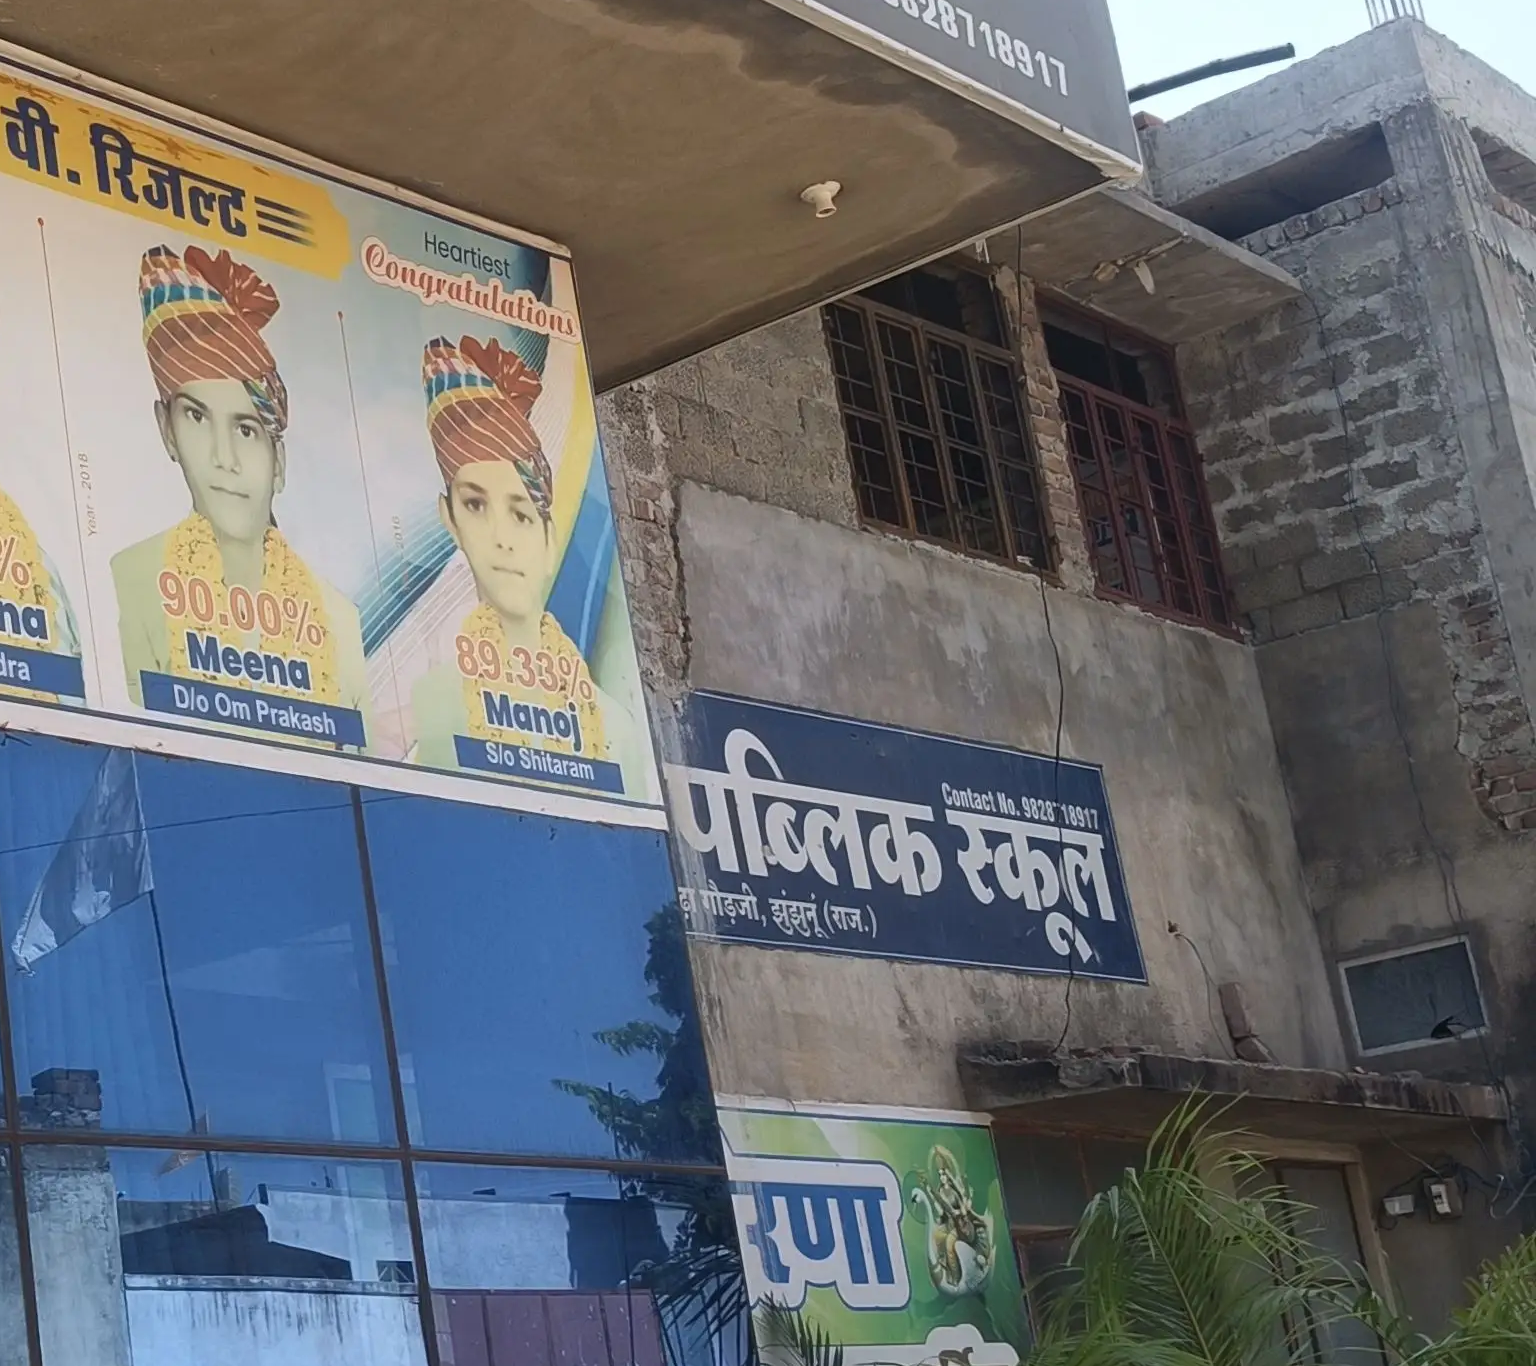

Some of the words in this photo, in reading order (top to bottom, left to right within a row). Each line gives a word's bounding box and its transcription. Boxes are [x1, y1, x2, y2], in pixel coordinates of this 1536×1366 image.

[0, 98, 80, 186] वी.
[90, 124, 248, 239] रिजल्ट
[424, 232, 511, 279] Heartiest
[366, 244, 576, 336] Congratulations
[79, 452, 92, 490] 2018
[87, 503, 98, 537] Year
[158, 570, 324, 648] 90.00%
[185, 631, 312, 692] Meena
[455, 634, 594, 702] 89.33%
[173, 685, 208, 715] D/o
[215, 695, 251, 721] Om
[257, 699, 337, 736] Prakash
[482, 691, 582, 751] Manoj
[486, 741, 516, 768] S/o
[520, 749, 595, 782] Shitaram
[941, 782, 997, 813] Contact
[997, 791, 1021, 817] No.
[665, 728, 942, 896] पब्लिक
[945, 808, 1116, 963] स्कूल
[823, 899, 877, 939] (राज.)
[731, 1180, 895, 1285] रणा
